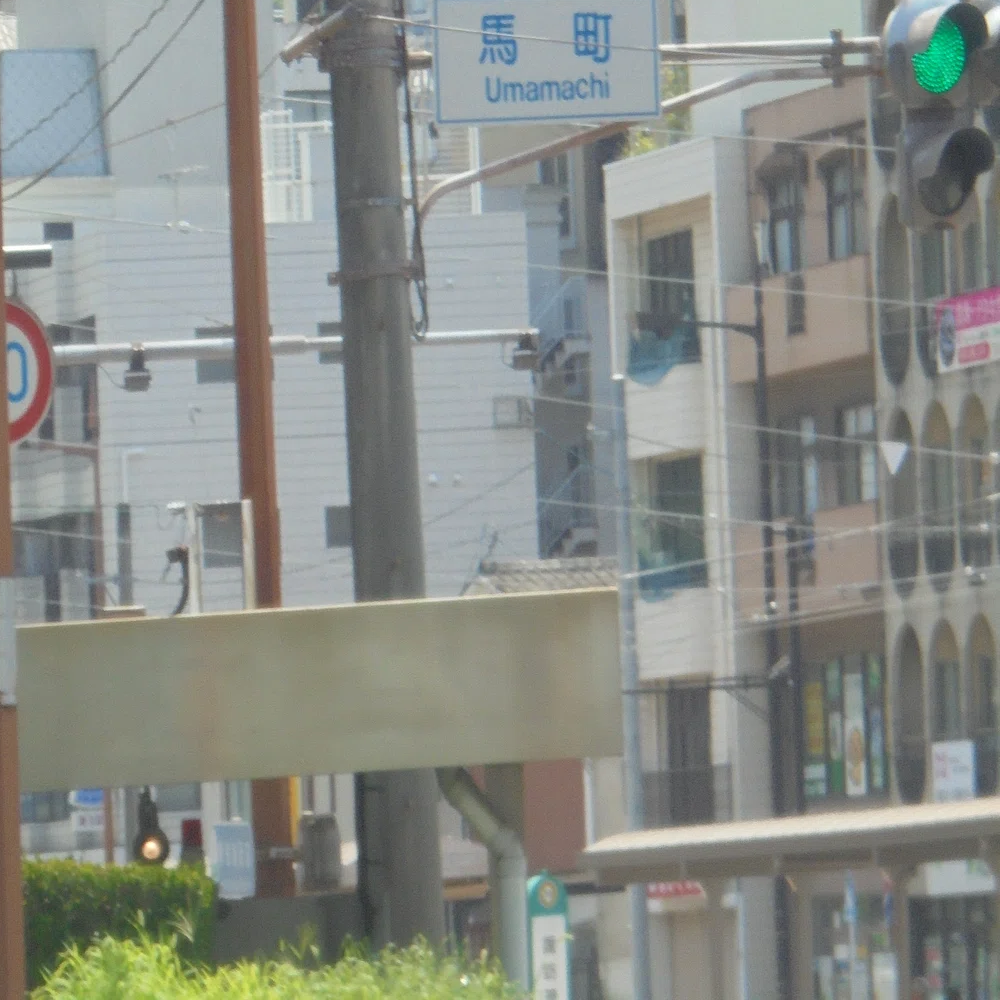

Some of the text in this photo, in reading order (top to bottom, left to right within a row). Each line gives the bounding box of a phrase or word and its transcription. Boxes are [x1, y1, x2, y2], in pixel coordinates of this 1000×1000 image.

[479, 12, 612, 66] 馬町
[484, 72, 610, 103] Umamachi
[6, 341, 28, 403] 0
